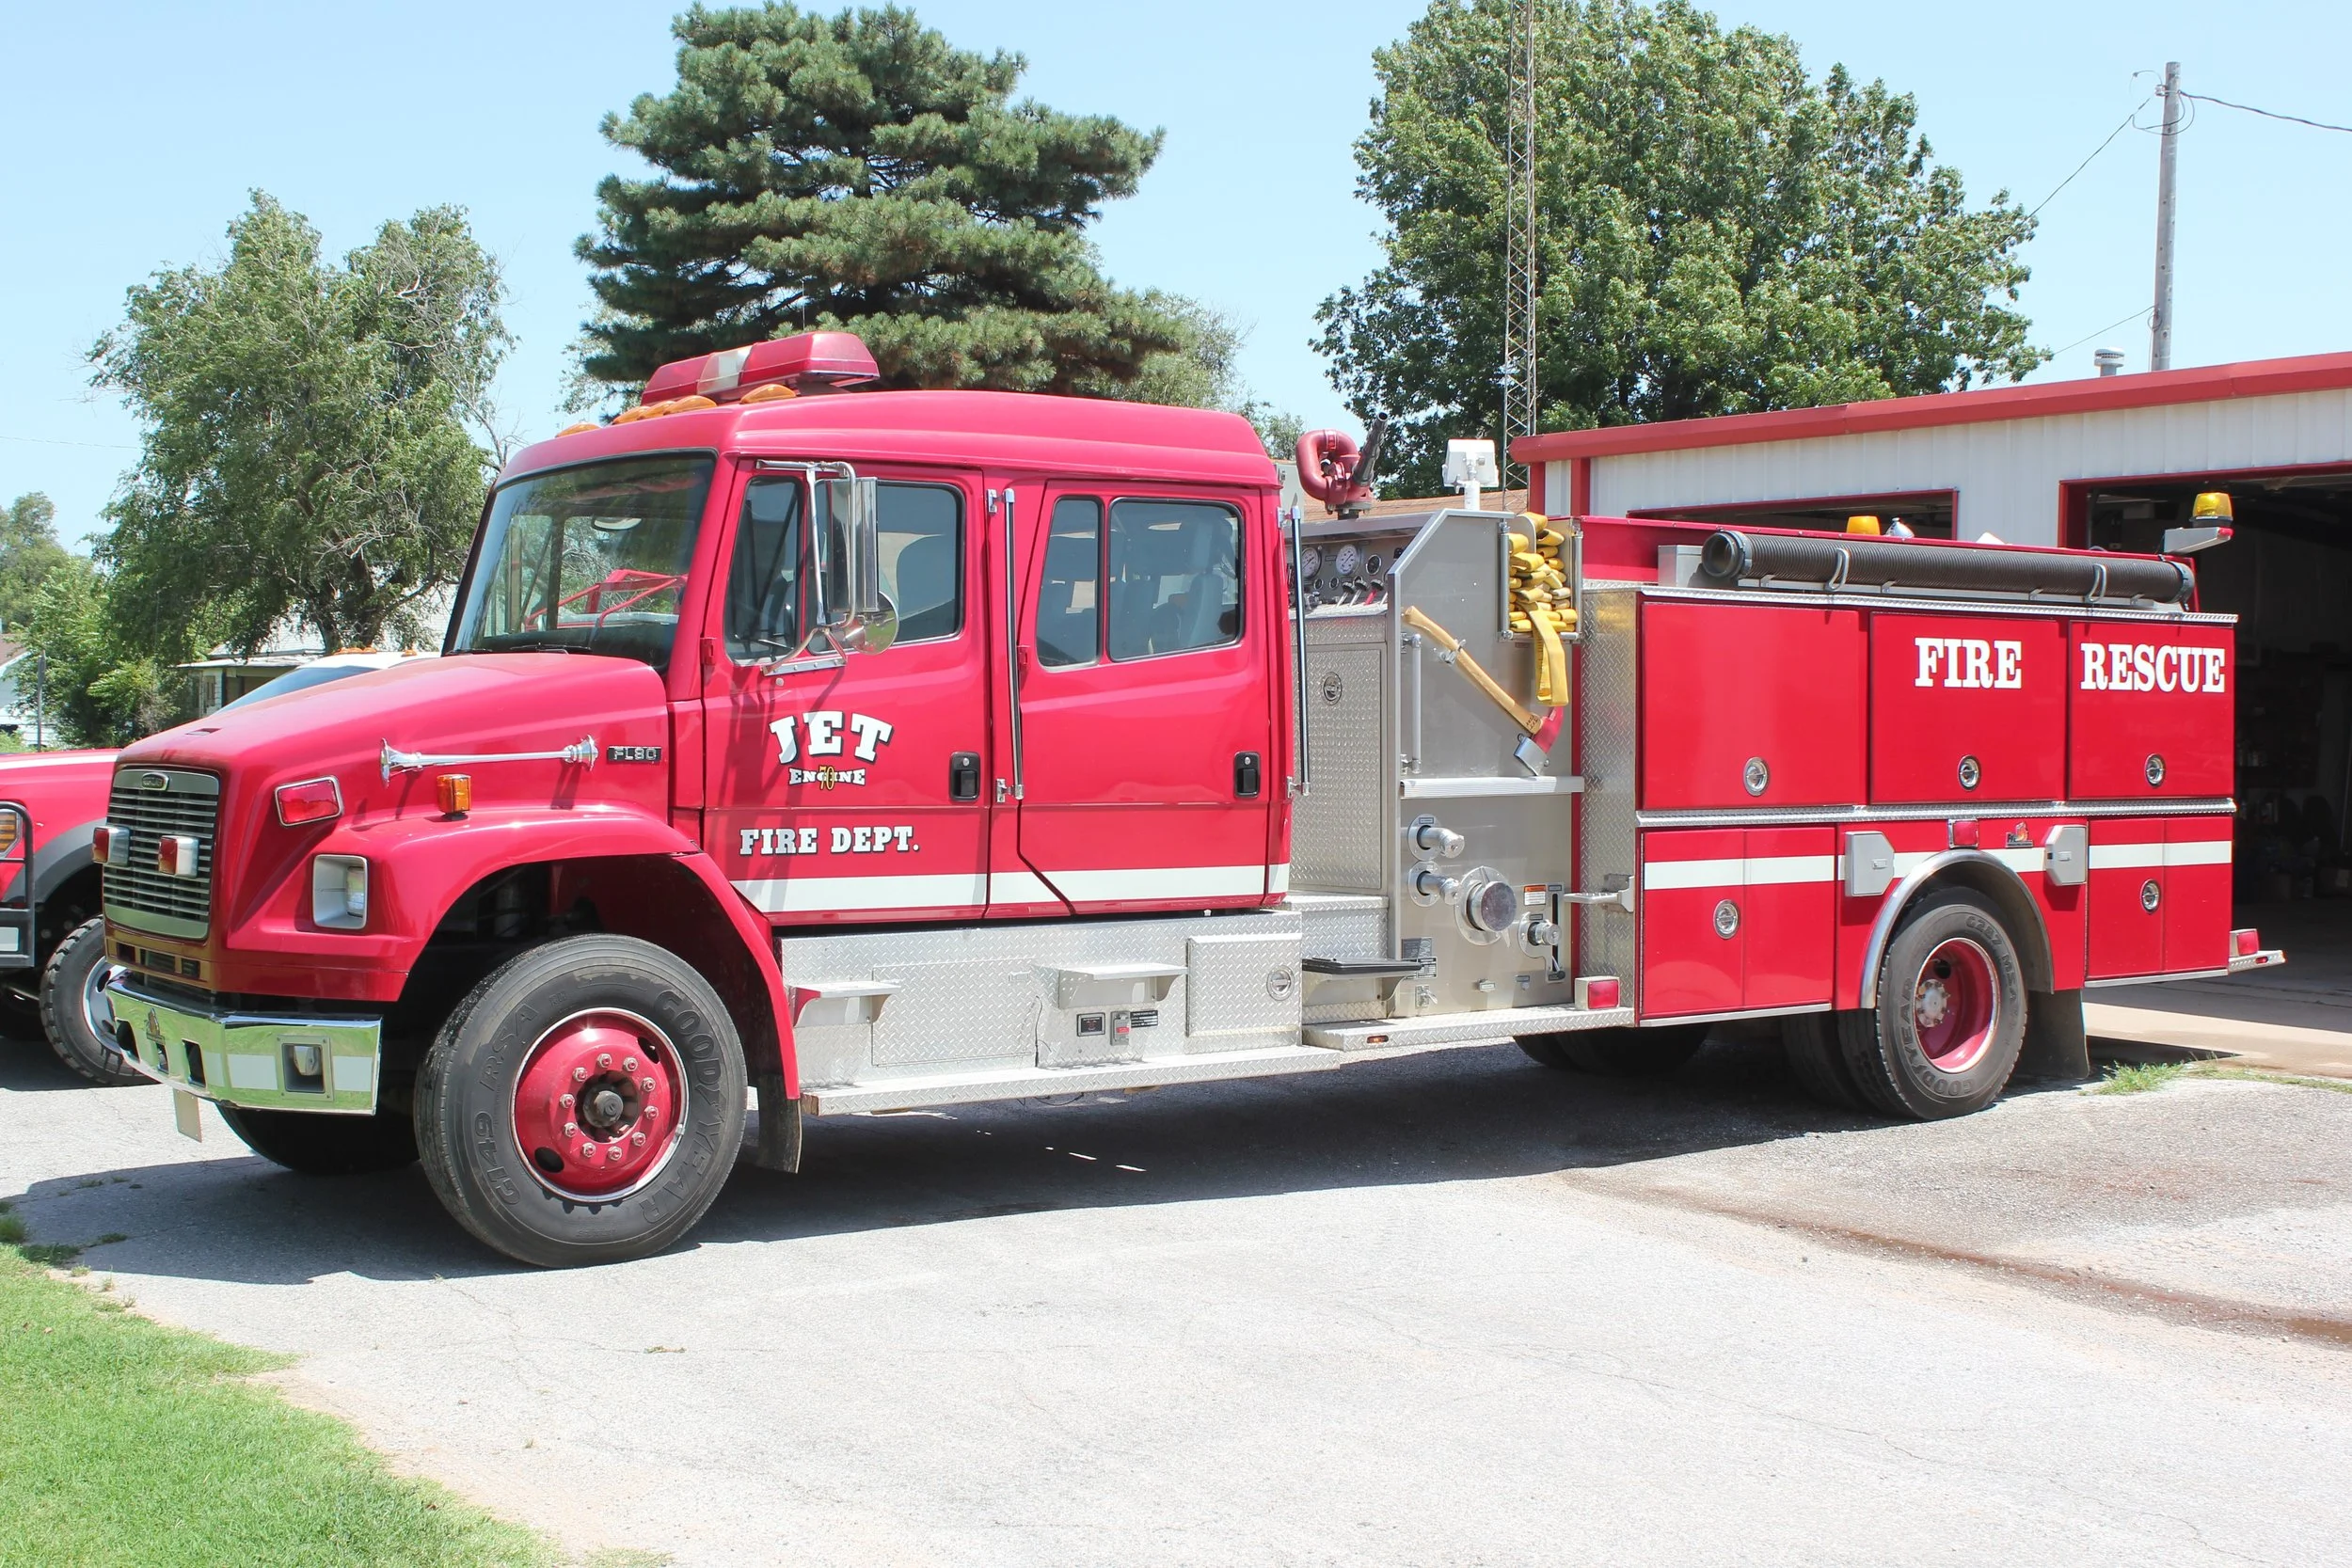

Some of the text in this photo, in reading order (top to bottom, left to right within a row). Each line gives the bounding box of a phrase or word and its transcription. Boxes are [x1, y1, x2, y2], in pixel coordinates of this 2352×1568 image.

[1914, 637, 2226, 693] FIRE RESCUE
[768, 710, 895, 765] JET
[788, 768, 866, 786] ENGINE
[739, 826, 920, 855] FIRE DEPT.
[1899, 977, 1973, 1097] GOODYEAR
[639, 990, 727, 1224] GOODYEAR
[474, 1111, 521, 1205] G149
